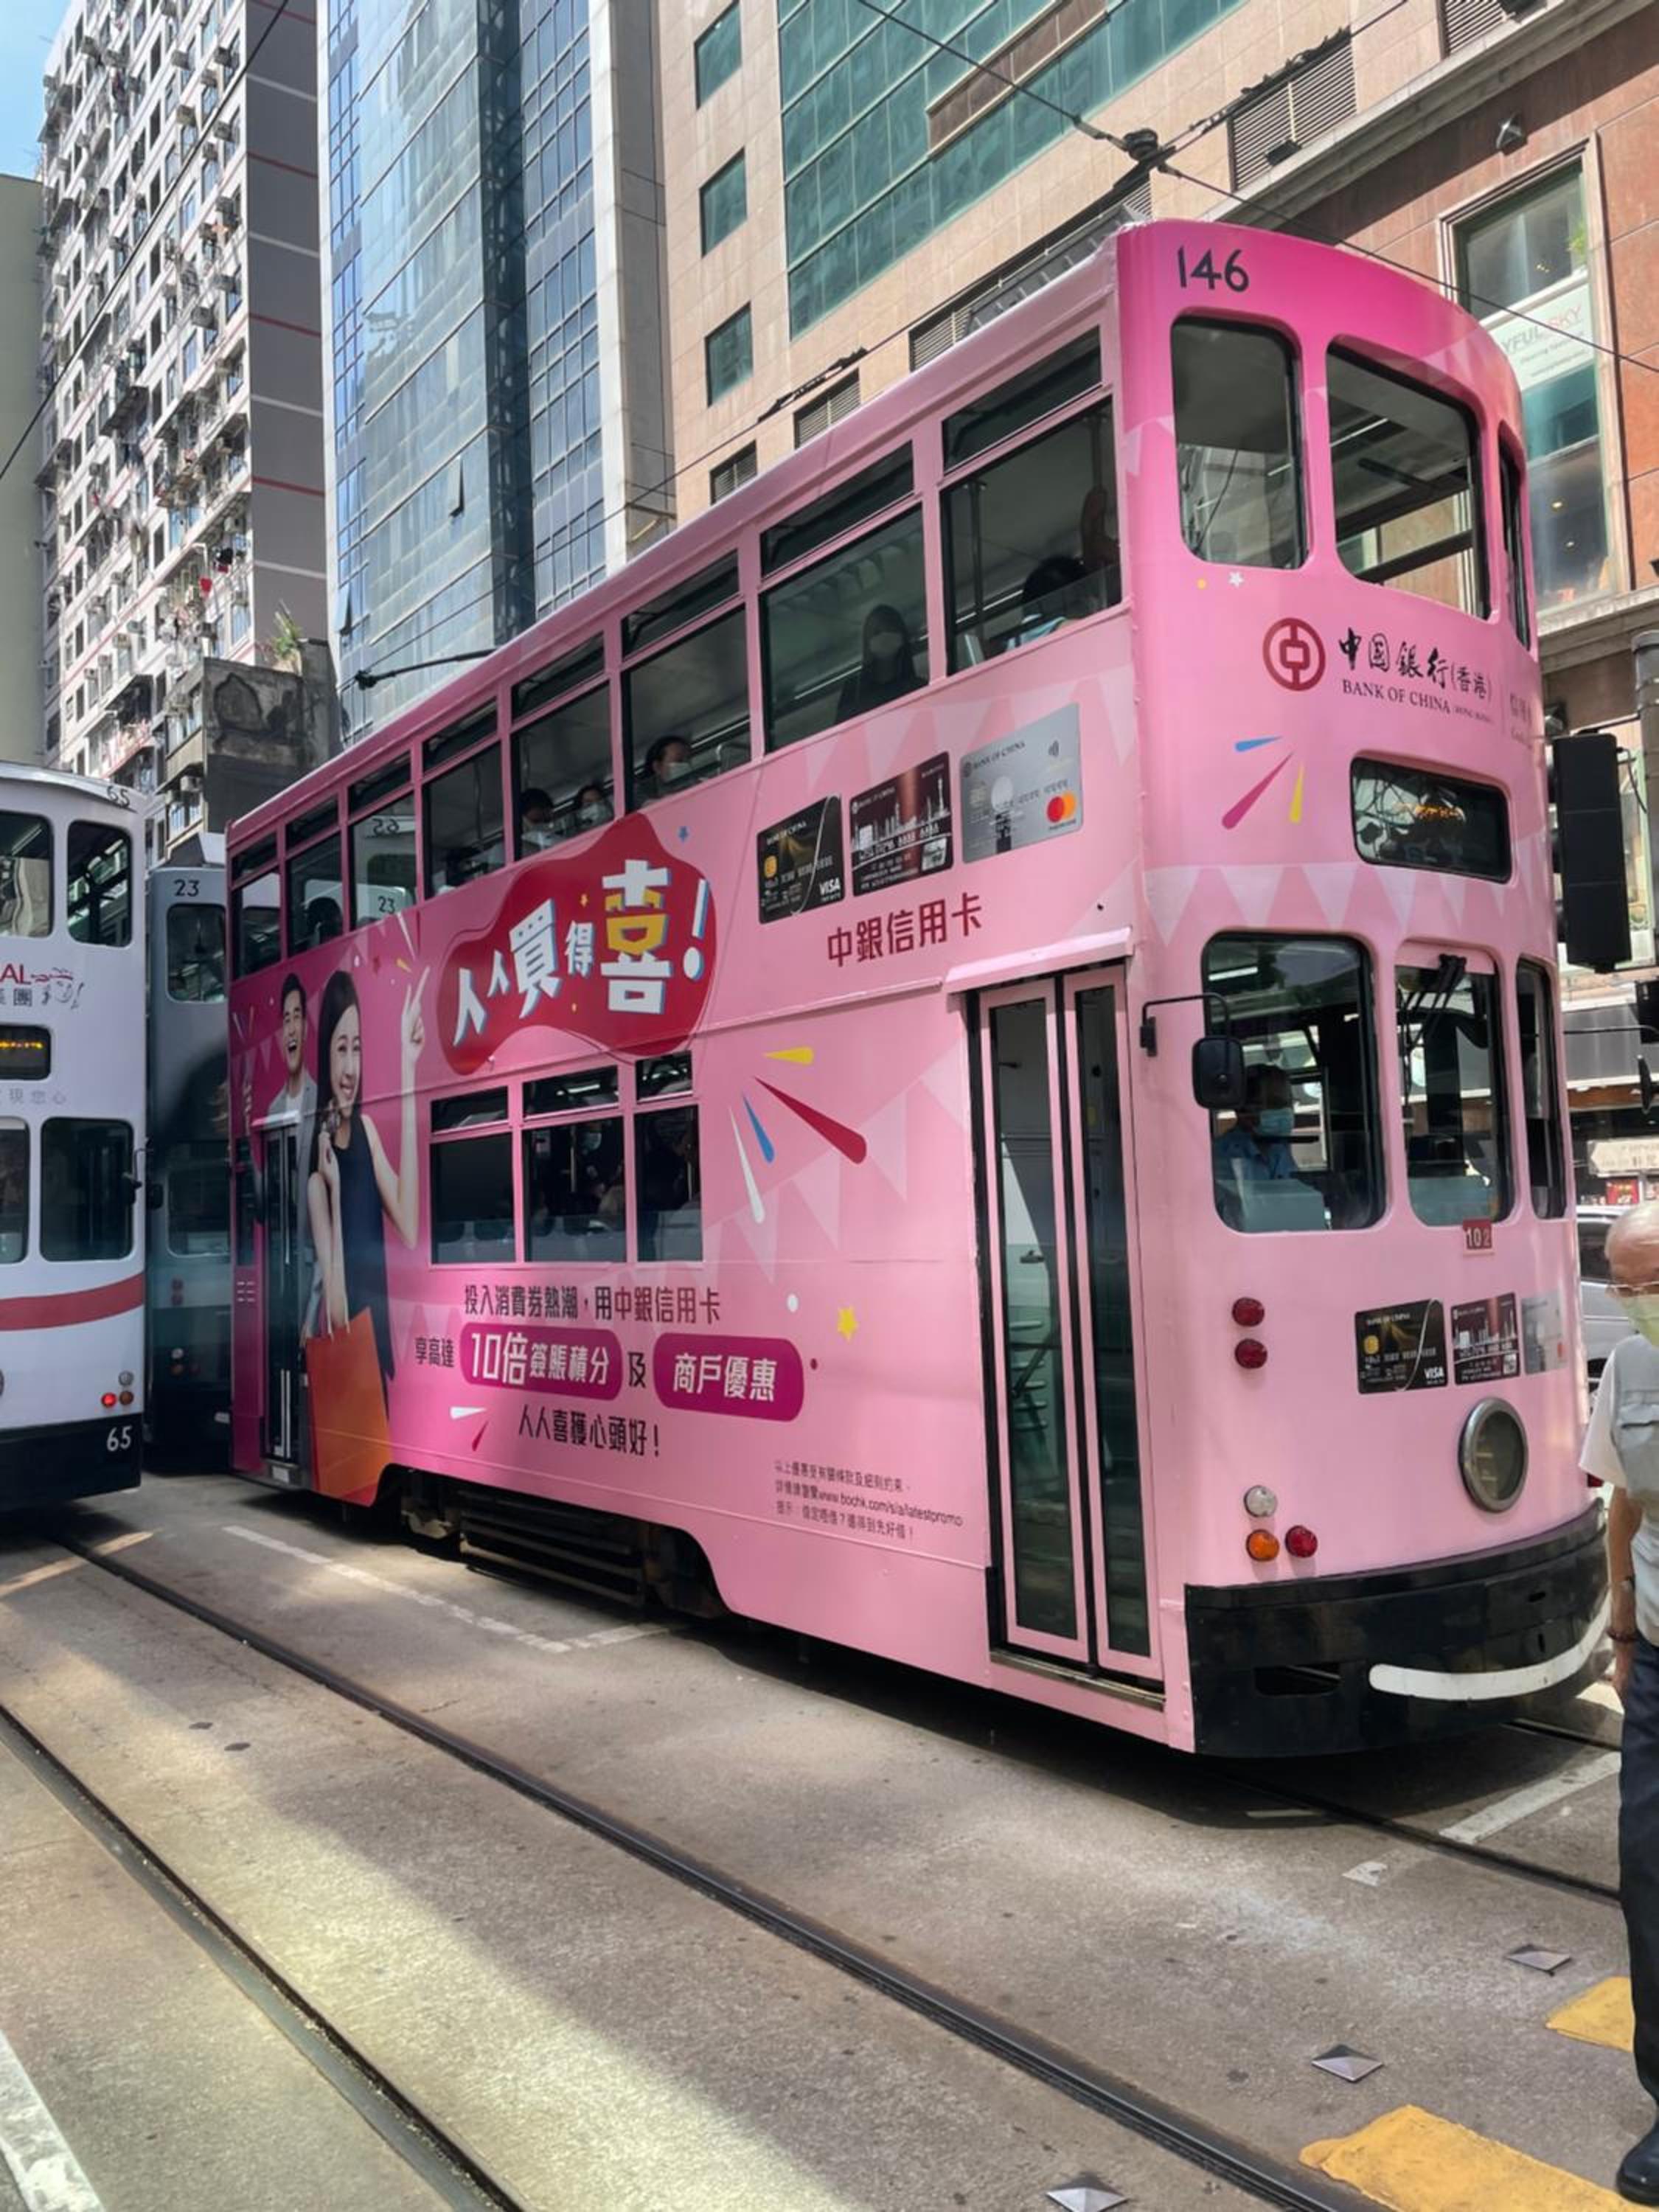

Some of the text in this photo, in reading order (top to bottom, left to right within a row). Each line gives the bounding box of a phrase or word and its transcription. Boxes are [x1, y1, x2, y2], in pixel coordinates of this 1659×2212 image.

[1178, 246, 1249, 292] 146
[1342, 678, 1385, 700] BANK
[1388, 686, 1405, 703] OF
[1409, 691, 1451, 714] CHINA
[106, 785, 131, 809] 65
[173, 878, 200, 897] 23
[819, 877, 841, 896] VISA
[378, 895, 396, 914] 23
[827, 892, 983, 967] 中銀信用卡
[627, 1351, 647, 1388] 及
[672, 1352, 778, 1402] 商戶優惠
[106, 1425, 133, 1452] 65
